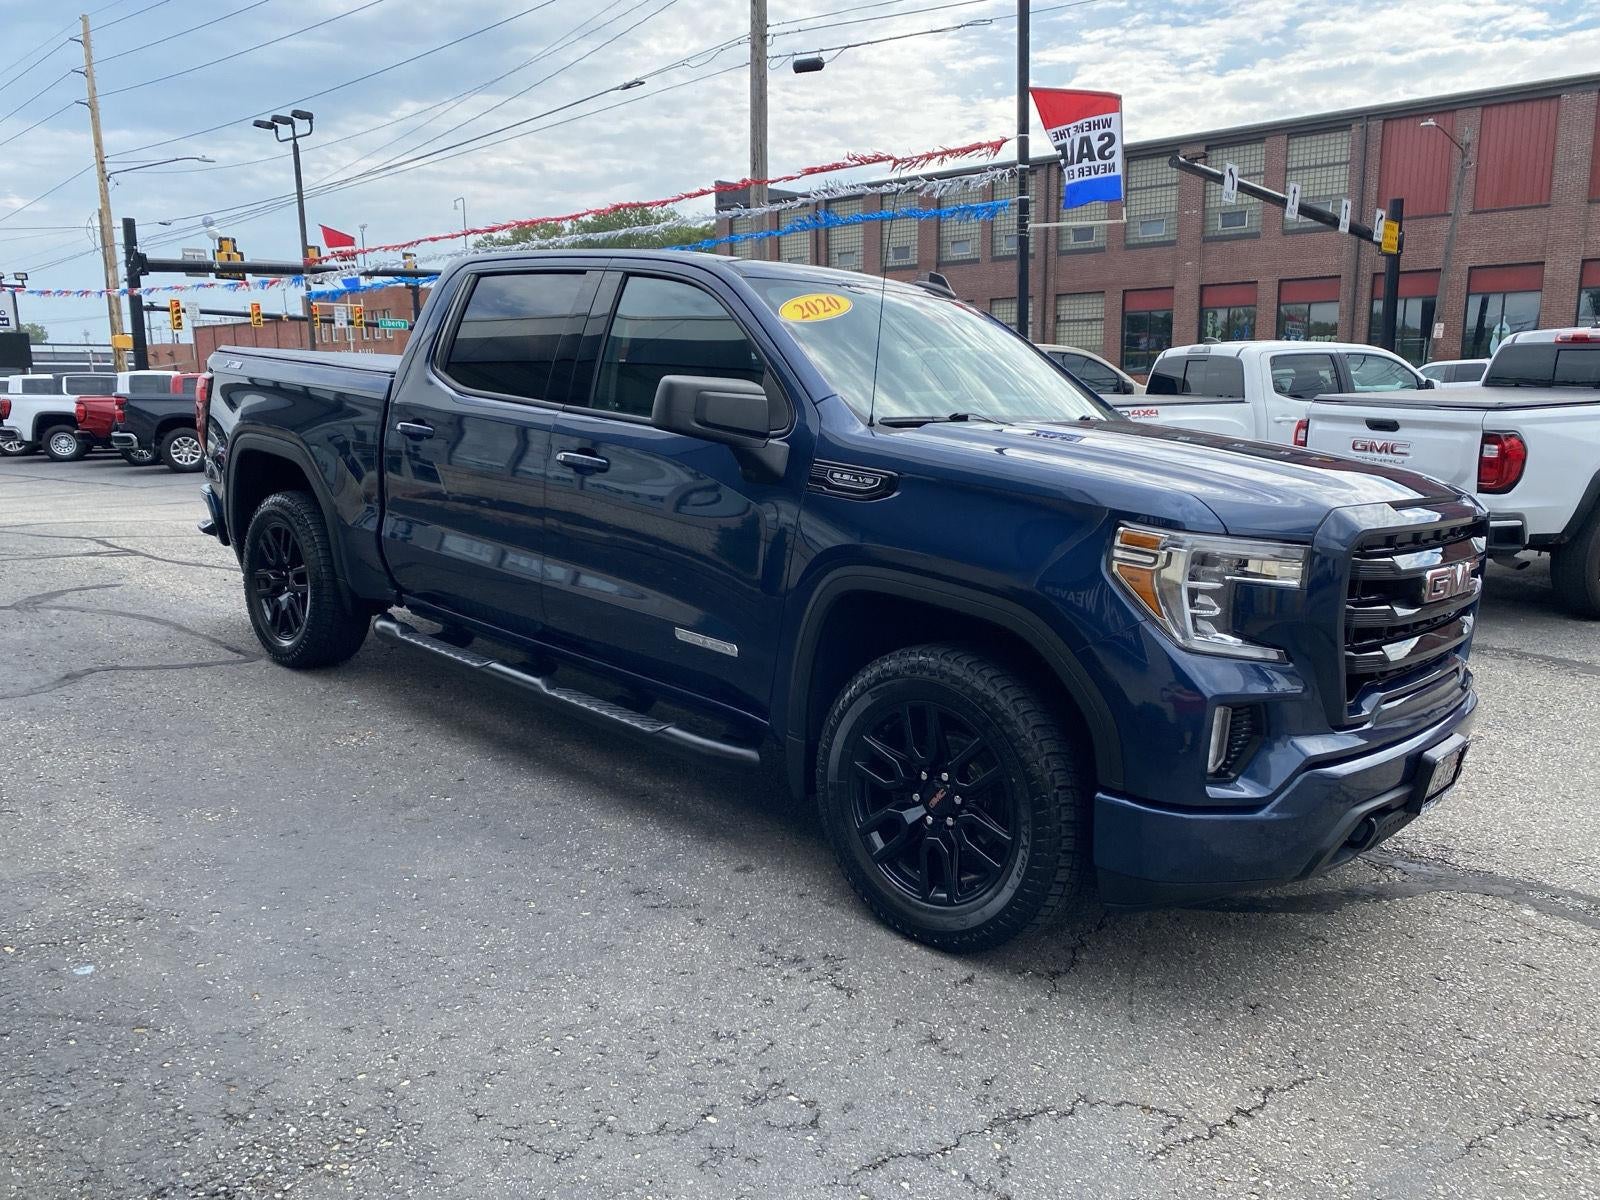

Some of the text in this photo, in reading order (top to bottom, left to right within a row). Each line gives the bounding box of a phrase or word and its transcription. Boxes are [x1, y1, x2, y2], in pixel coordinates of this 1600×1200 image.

[793, 295, 841, 320] 2020
[381, 319, 406, 329] Liberty
[1352, 439, 1410, 456] GMC
[1424, 561, 1482, 603] GMC
